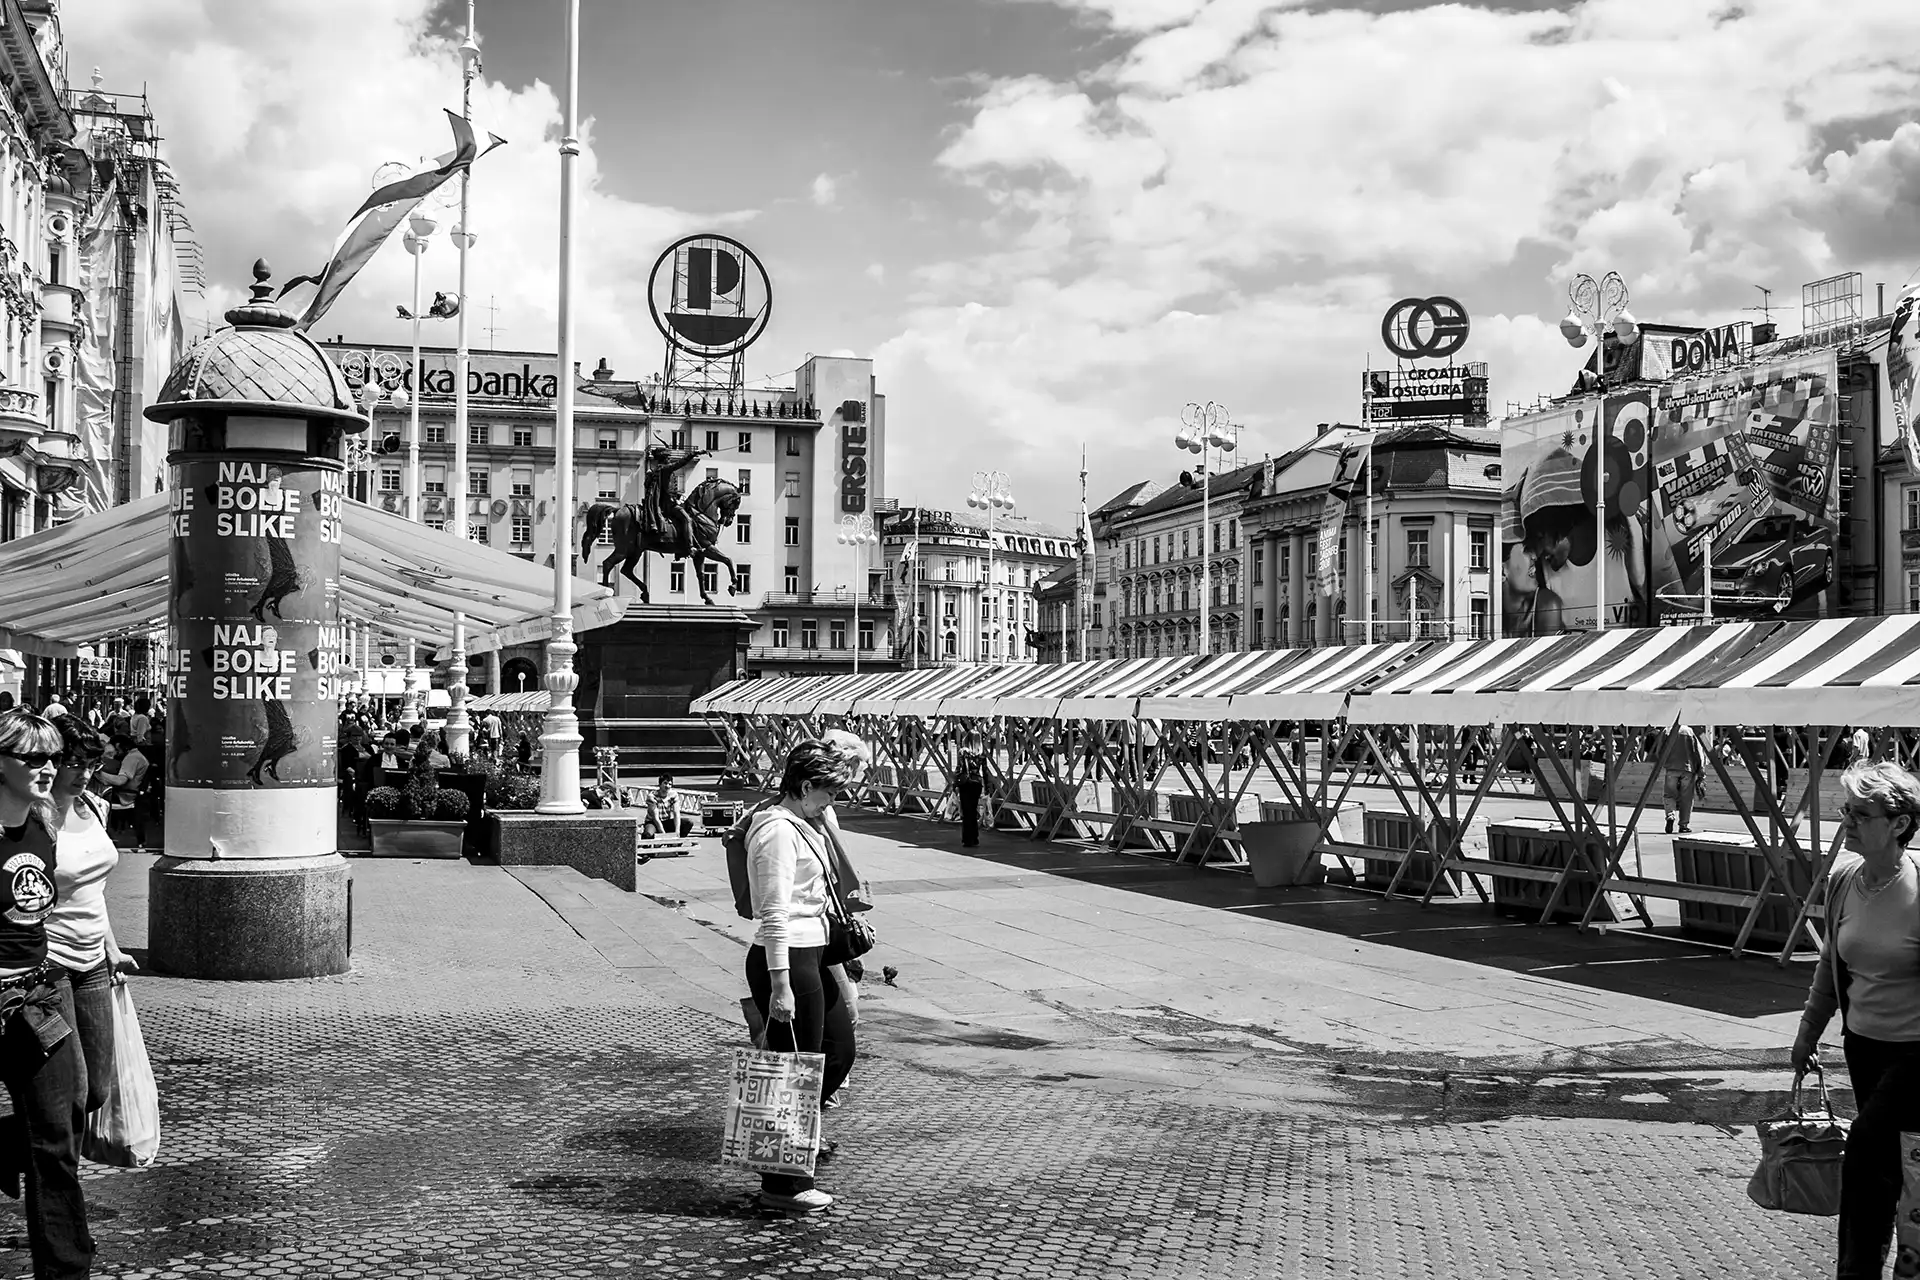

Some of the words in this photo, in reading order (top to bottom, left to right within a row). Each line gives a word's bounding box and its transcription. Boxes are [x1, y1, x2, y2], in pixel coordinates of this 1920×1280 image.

[1671, 325, 1739, 371] DONA
[468, 362, 558, 397] banka
[1408, 364, 1472, 380] CROATIA
[1751, 427, 1798, 446] VATRENA
[218, 462, 267, 483] NAJ
[842, 425, 866, 512] ERSTE
[1664, 455, 1726, 494] VATRENA
[218, 487, 300, 512] BOLJE
[217, 513, 296, 539] SLIKE
[1613, 597, 1640, 627] vip
[213, 625, 262, 646] NAJ
[213, 649, 297, 673] BOLJE
[213, 676, 292, 700] SLIKE
